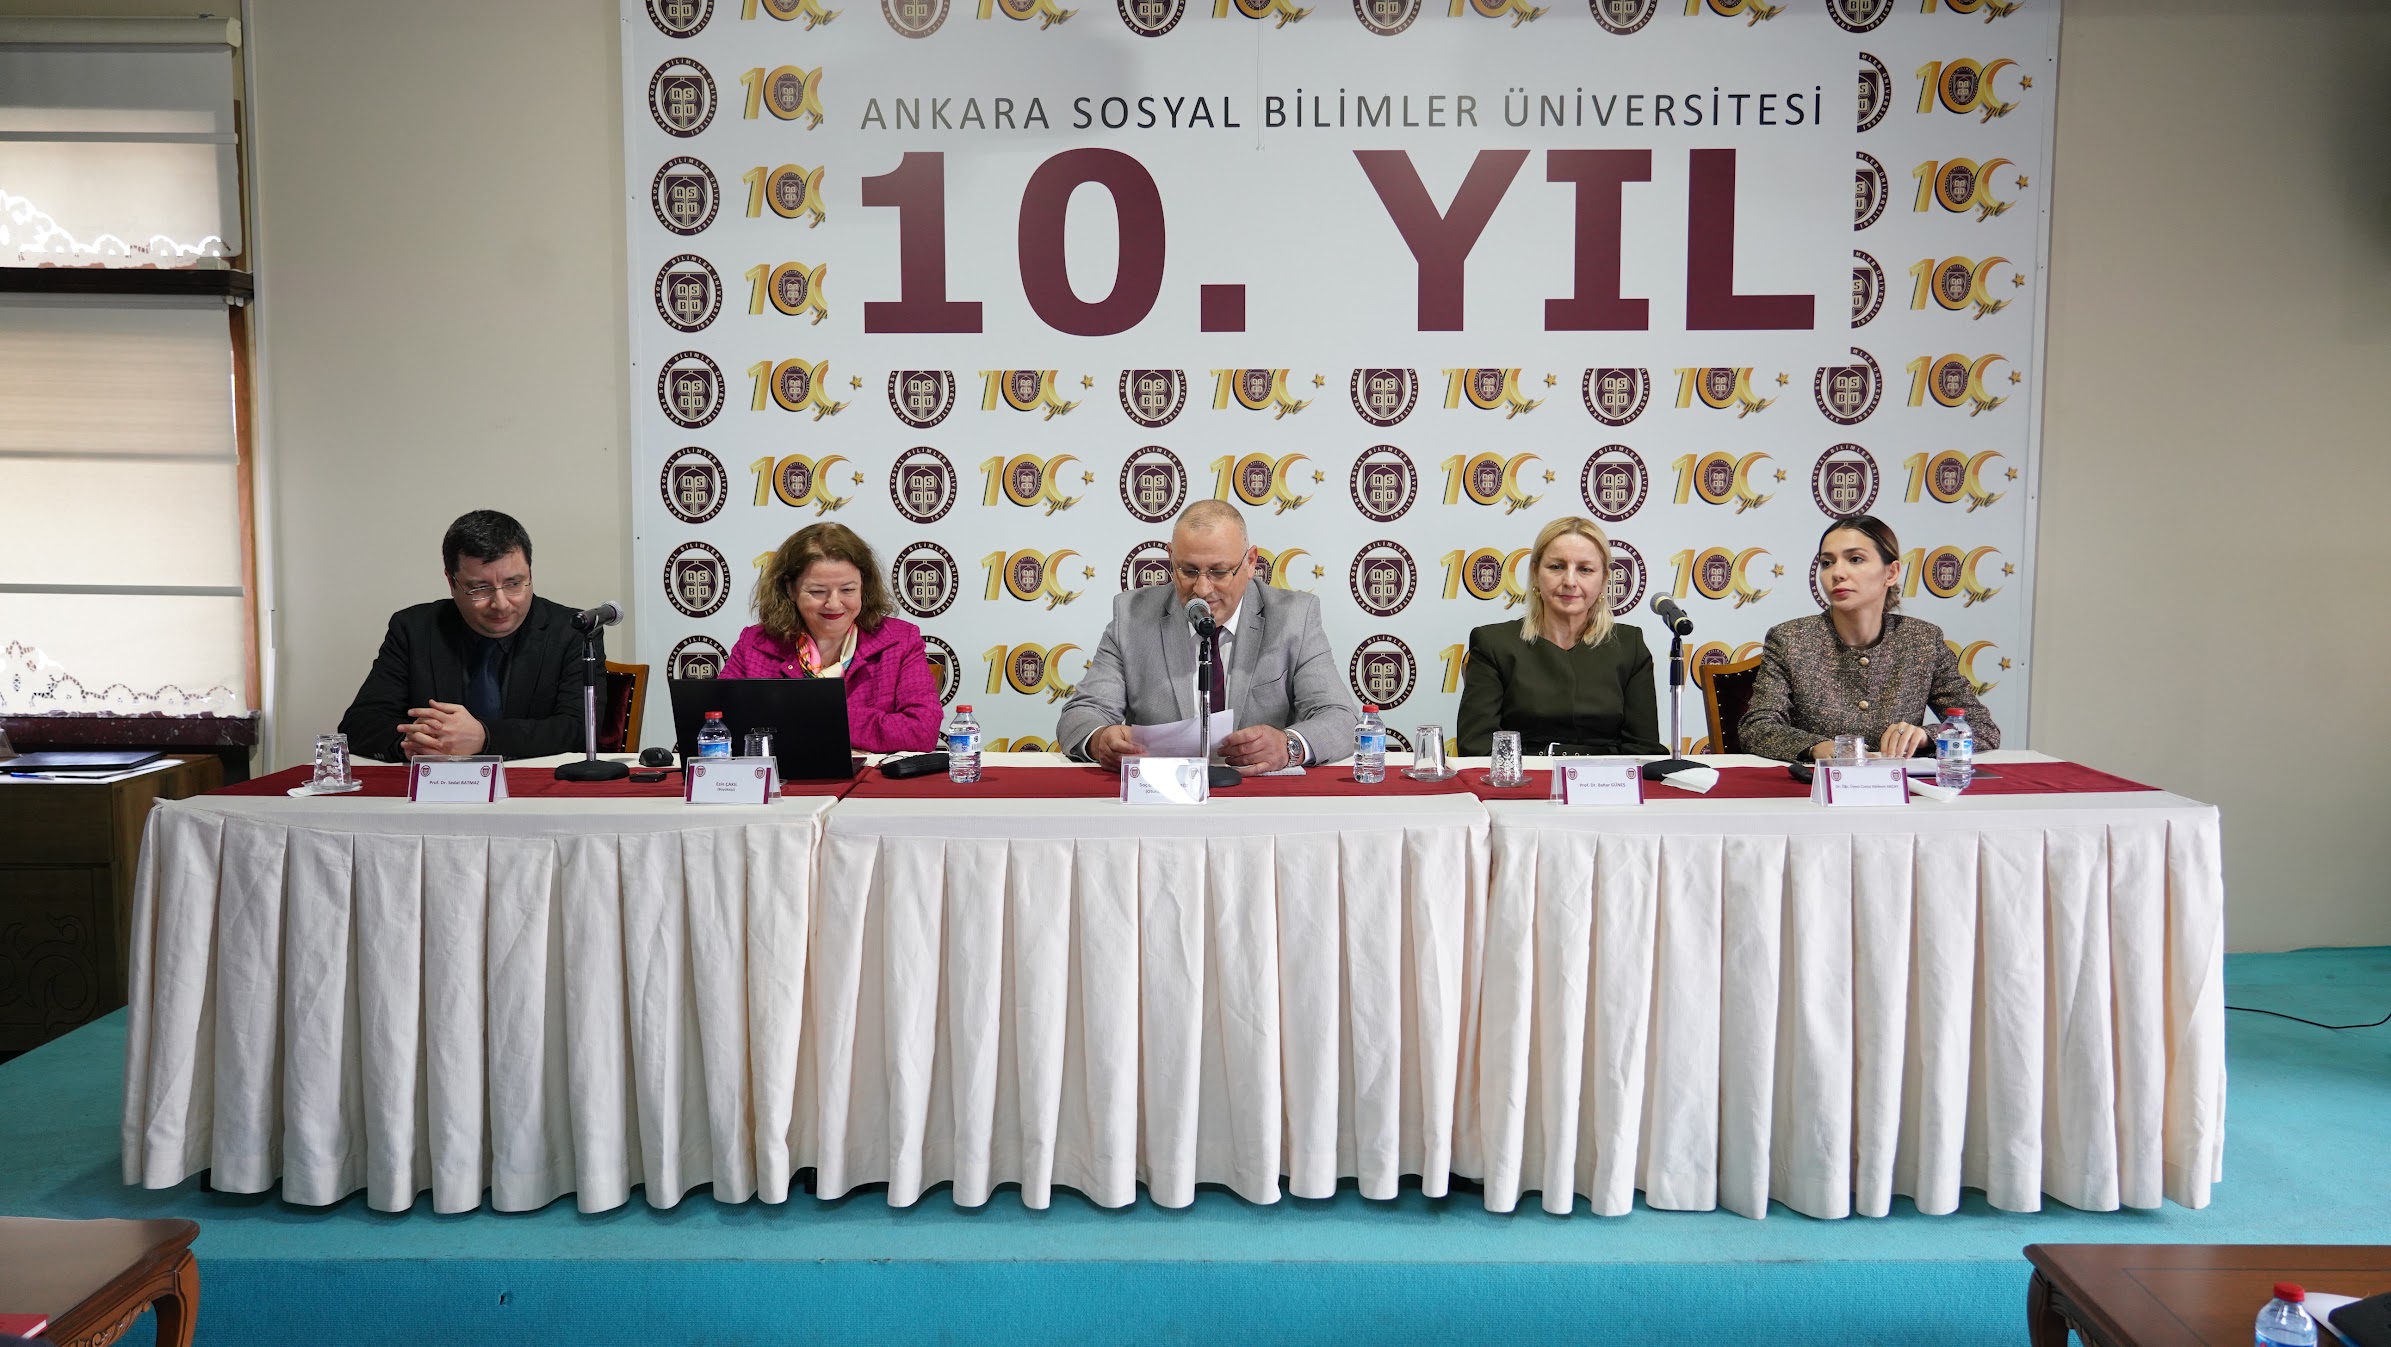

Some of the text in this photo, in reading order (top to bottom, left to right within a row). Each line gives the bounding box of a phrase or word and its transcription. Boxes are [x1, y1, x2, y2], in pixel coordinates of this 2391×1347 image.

[861, 97, 1050, 130] ANKARA
[1072, 96, 1241, 130] SOSYAL
[1265, 87, 1478, 128] BİLİMLER
[1504, 85, 1821, 128] ÜNİVERSİTESİ
[862, 147, 1247, 337] 10.
[1353, 147, 1816, 332] YIL
